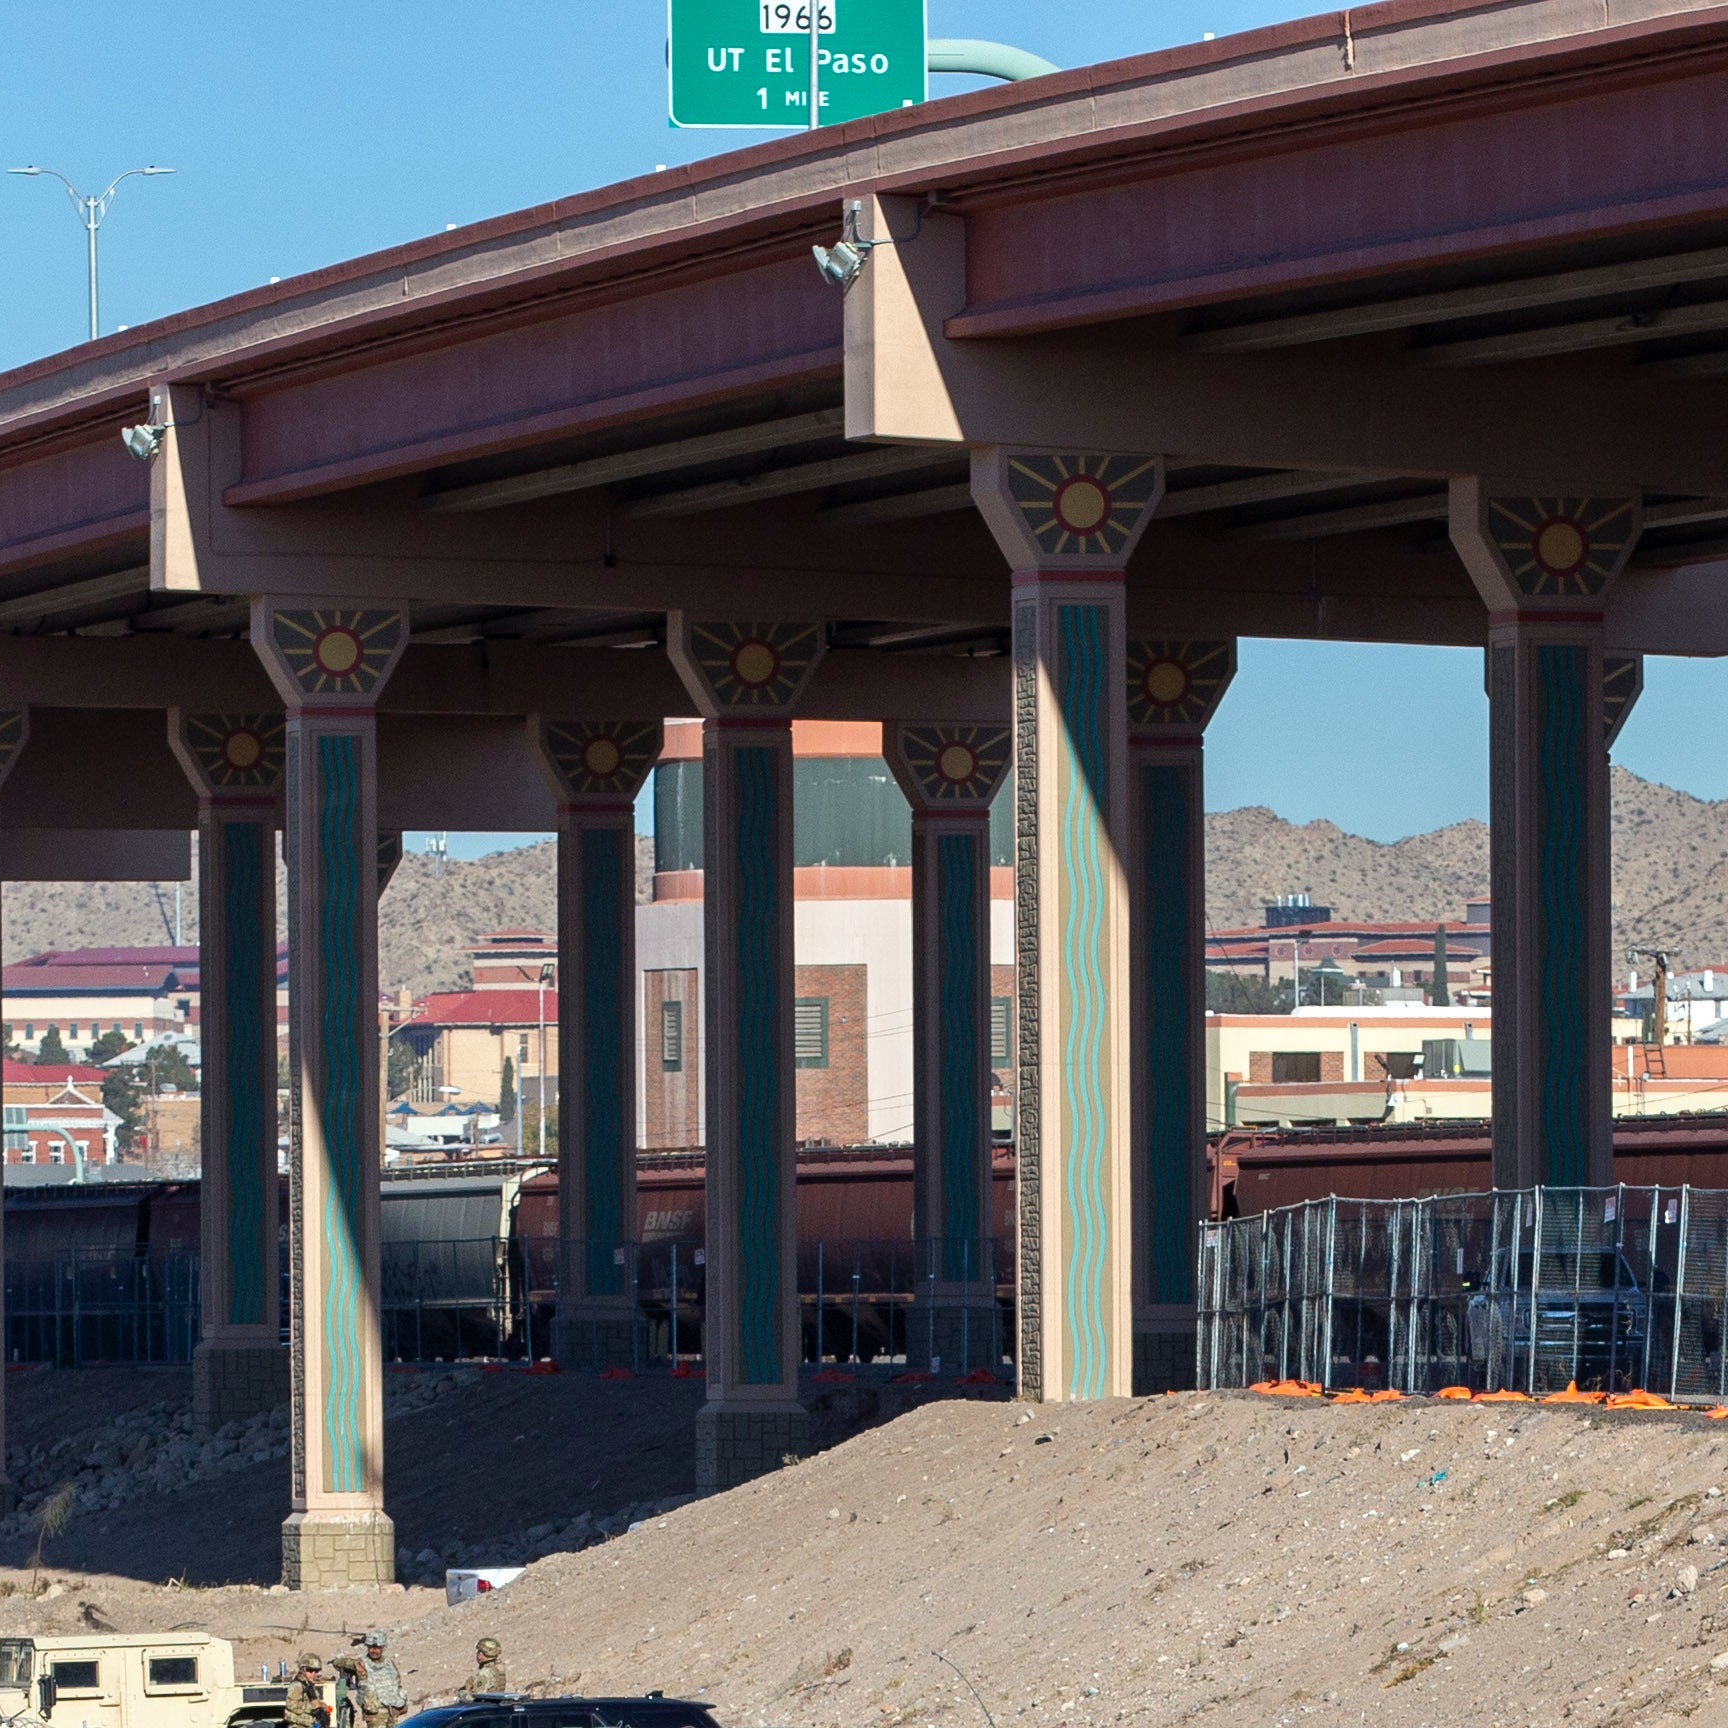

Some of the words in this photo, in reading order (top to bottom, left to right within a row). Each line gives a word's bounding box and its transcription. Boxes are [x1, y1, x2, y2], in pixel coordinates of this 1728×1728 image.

[762, 4, 833, 31] 1966
[707, 47, 745, 72] UT
[766, 48, 794, 73] El
[817, 49, 889, 74] Paso
[756, 87, 768, 110] 1
[785, 91, 830, 107] MIE
[644, 1209, 694, 1231] BNSF
